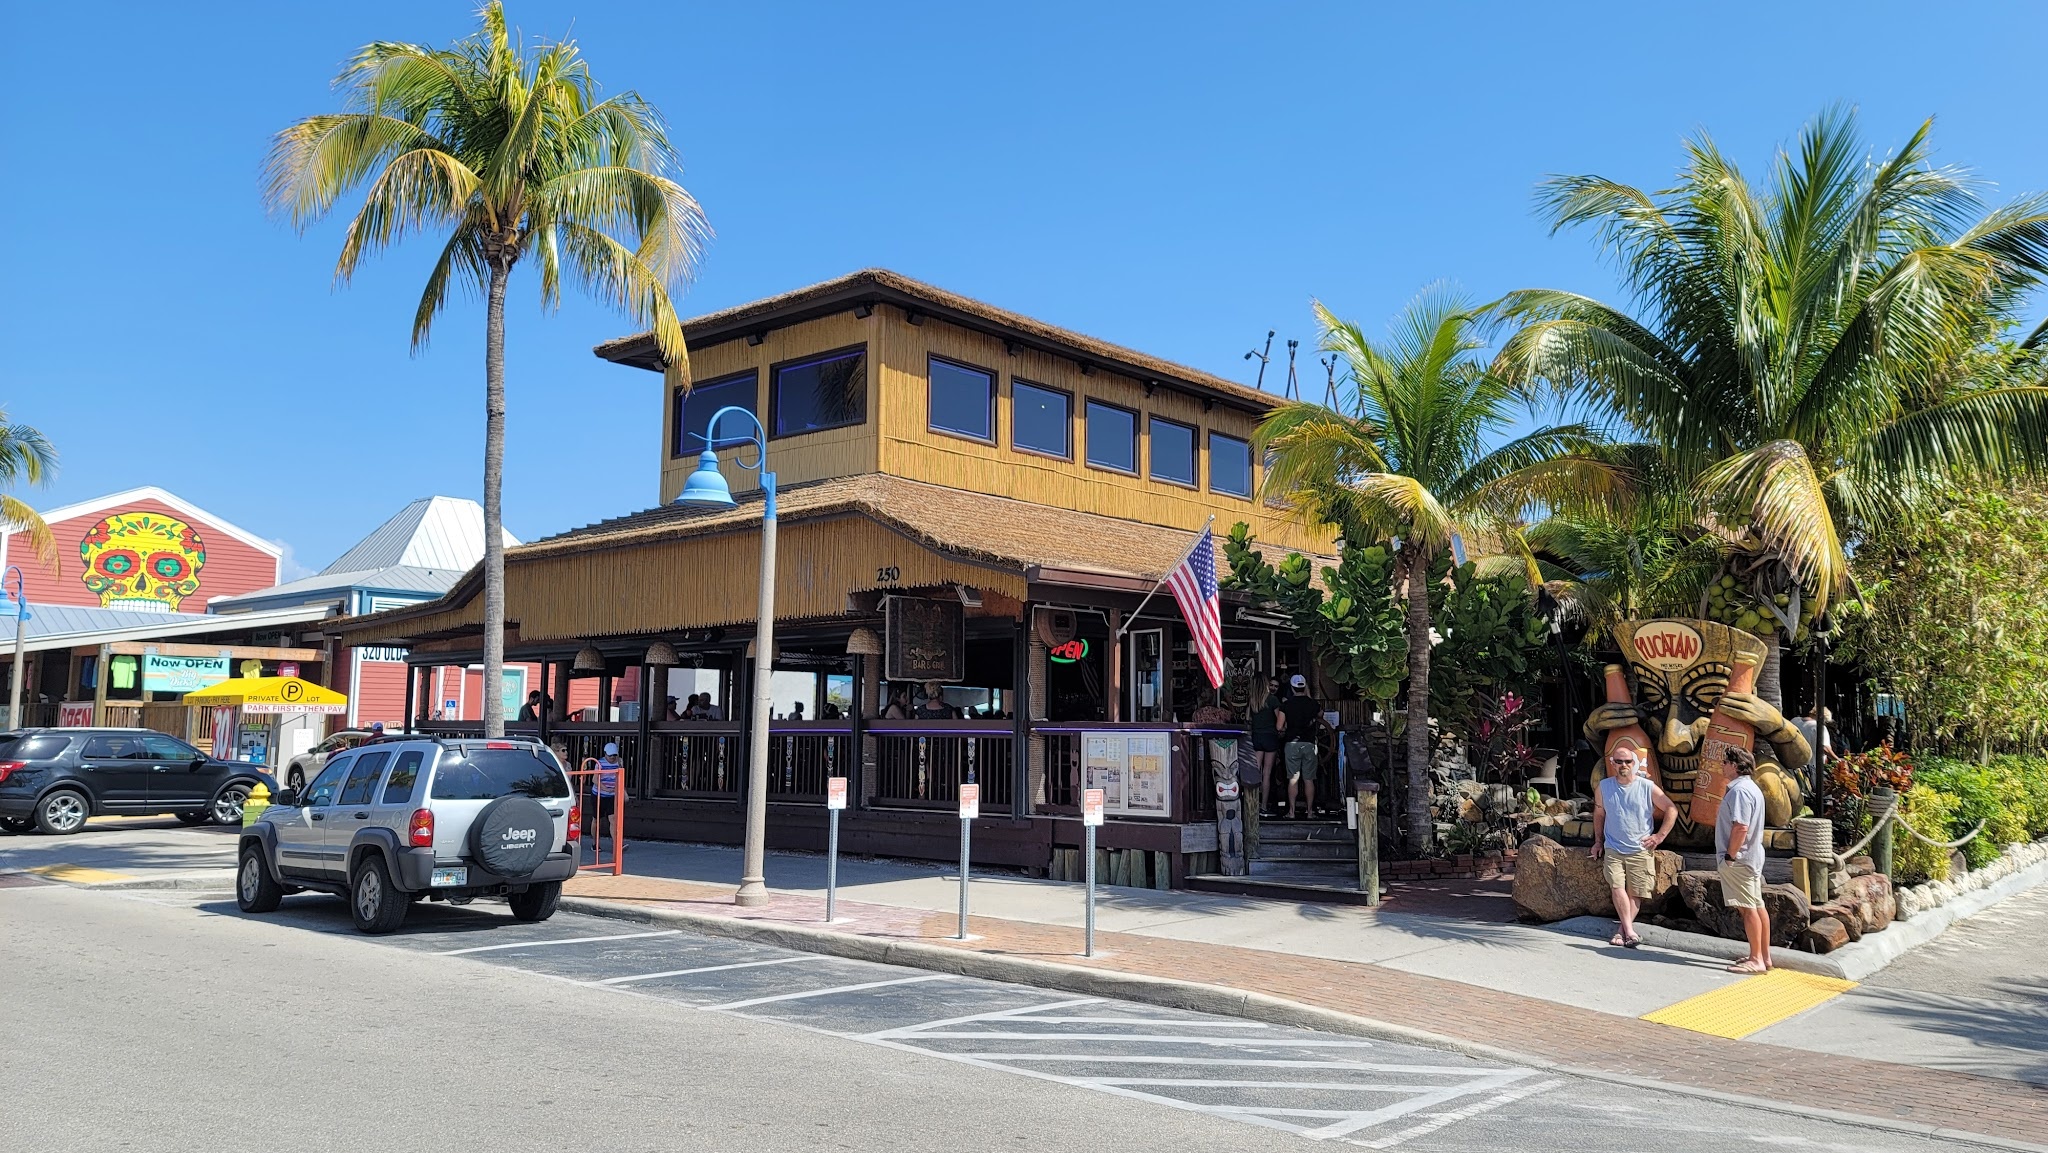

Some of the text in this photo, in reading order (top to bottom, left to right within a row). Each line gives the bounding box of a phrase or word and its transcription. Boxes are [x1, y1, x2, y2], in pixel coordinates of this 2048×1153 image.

[877, 566, 900, 582] 250
[1634, 631, 1698, 660] YUCATAN
[362, 647, 402, 661] 320 OLD
[150, 657, 224, 669] Now OPEN
[912, 660, 926, 669] BAR
[181, 669, 197, 680] Big
[287, 685, 299, 698] P
[247, 704, 270, 712] PARK
[301, 705, 326, 713] THEN
[61, 708, 92, 727] OPEN
[502, 827, 536, 842] Jeep
